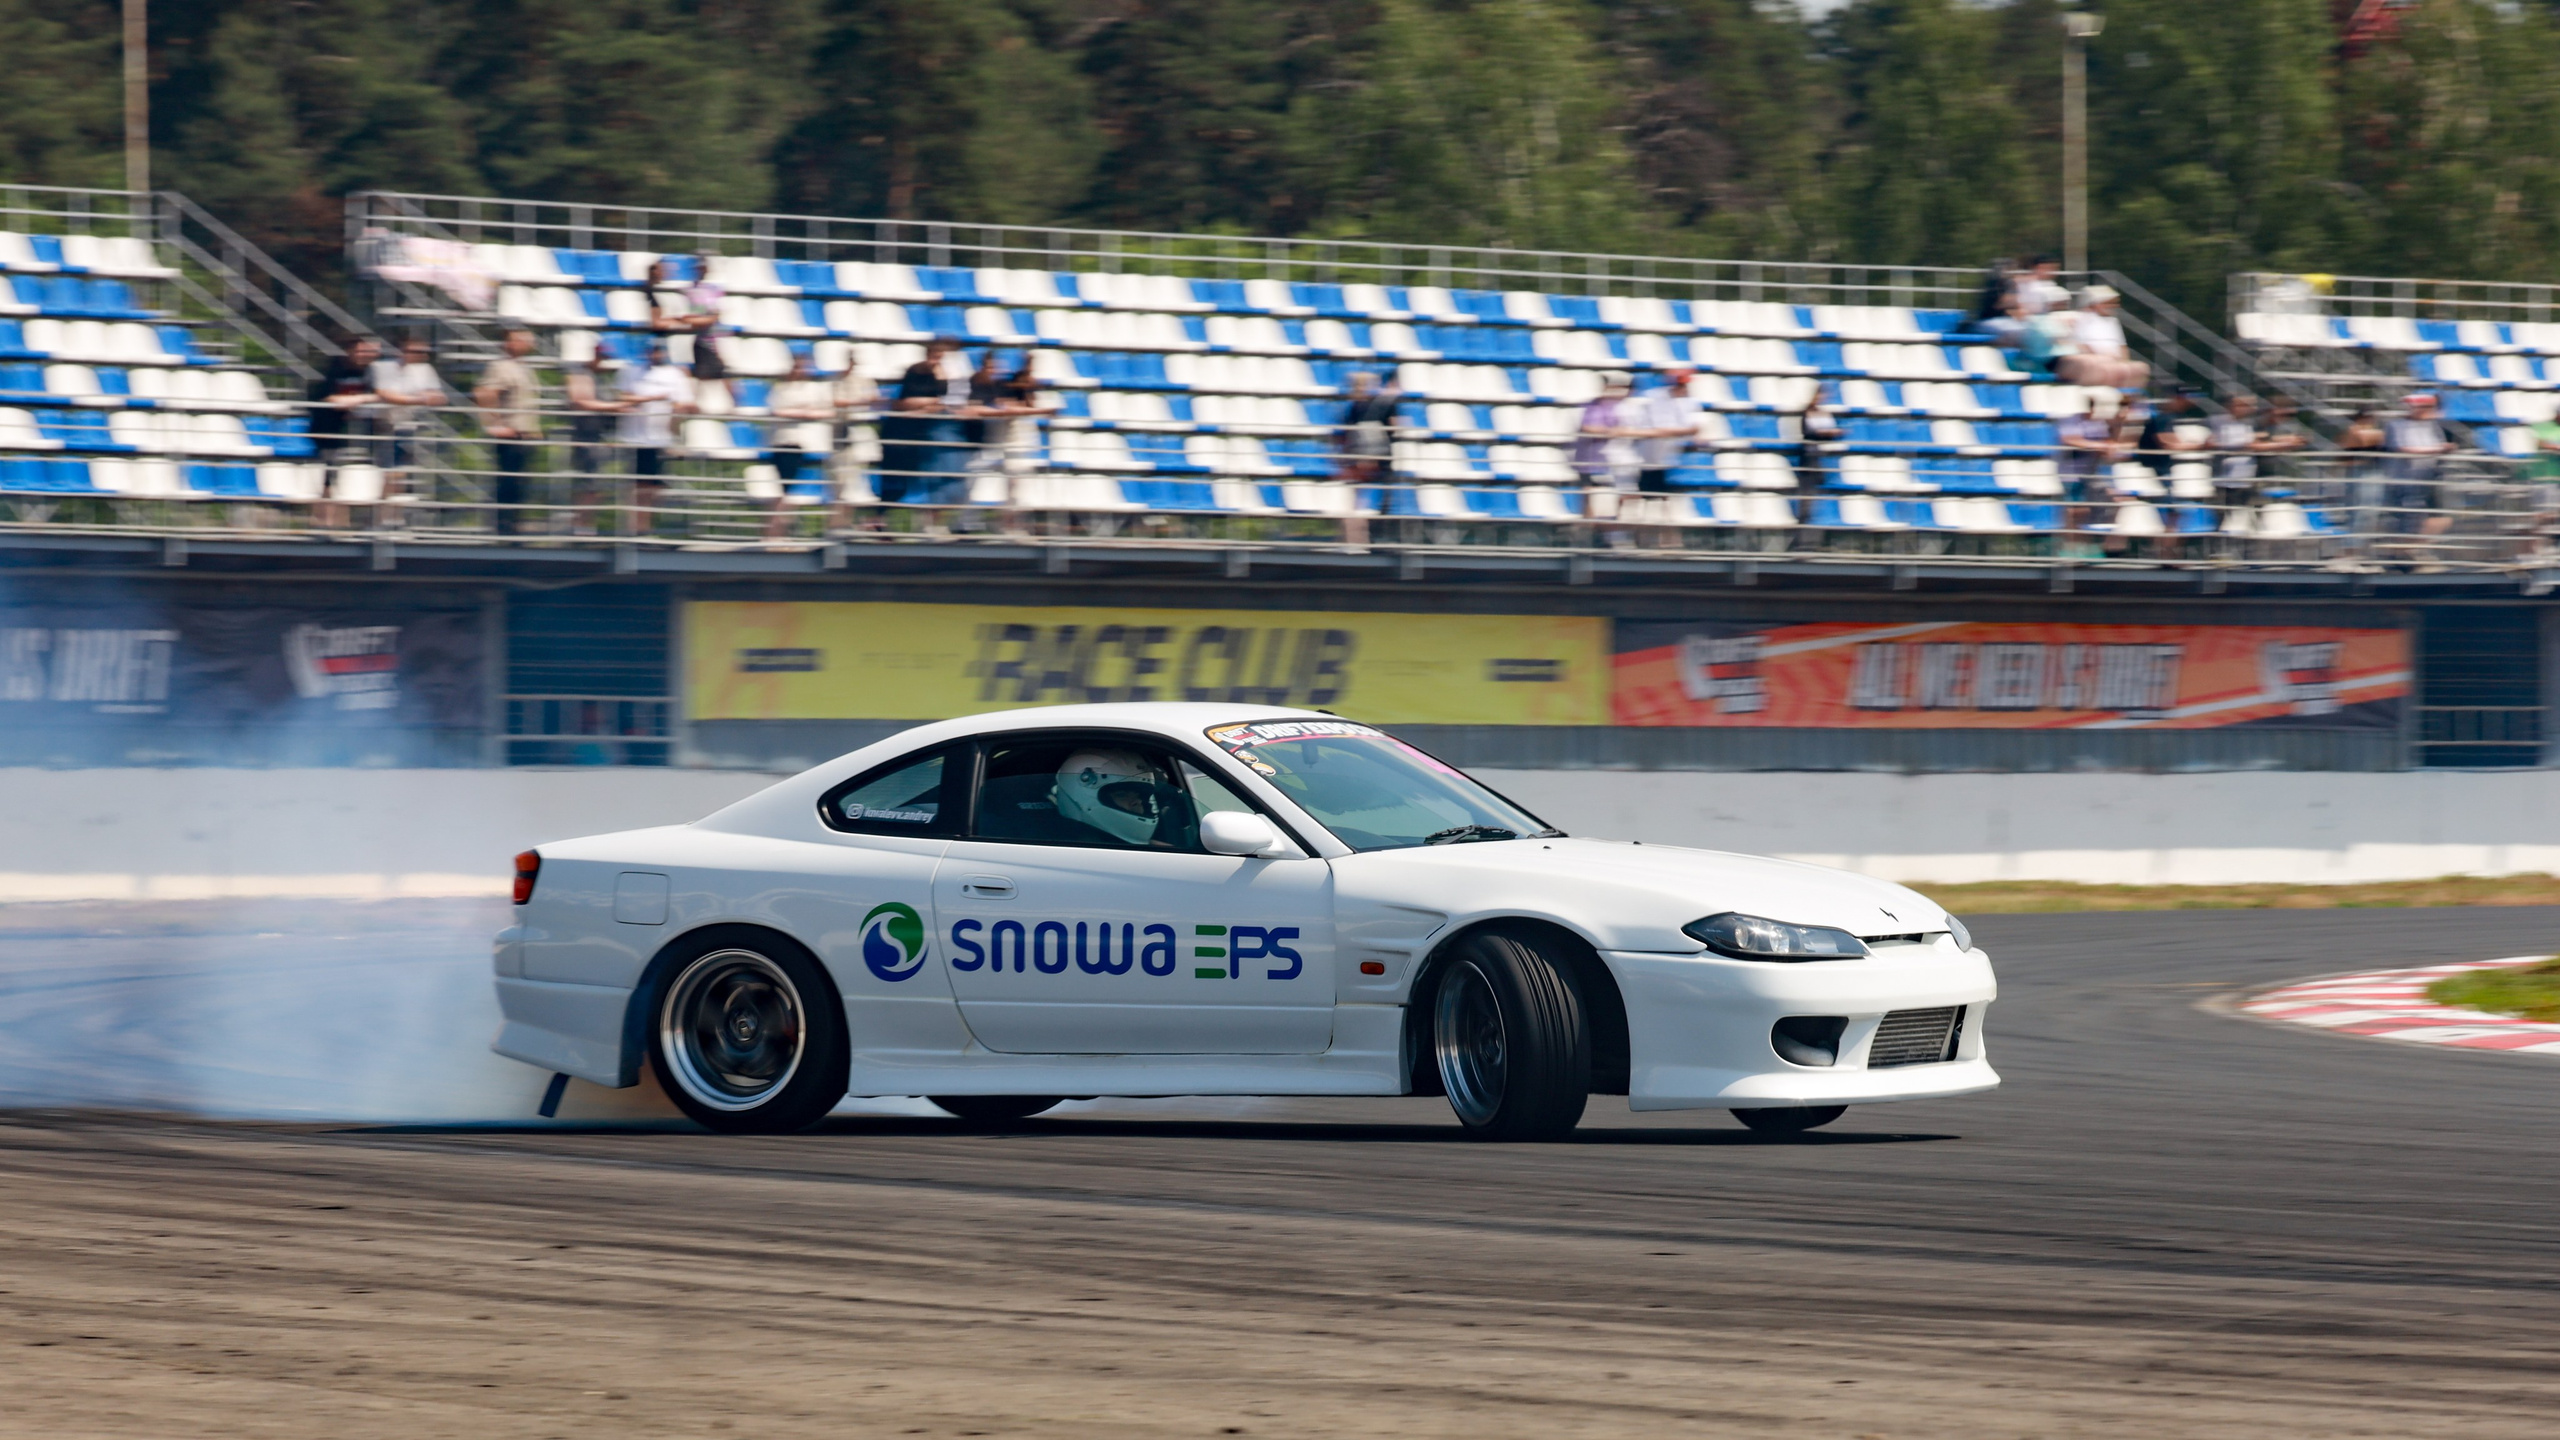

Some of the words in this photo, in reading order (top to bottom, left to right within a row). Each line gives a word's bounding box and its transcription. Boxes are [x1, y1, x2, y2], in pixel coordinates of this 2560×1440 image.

[968, 622, 1178, 703] RACE
[1178, 625, 1358, 705] CLUB
[1194, 924, 1304, 980] EPS
